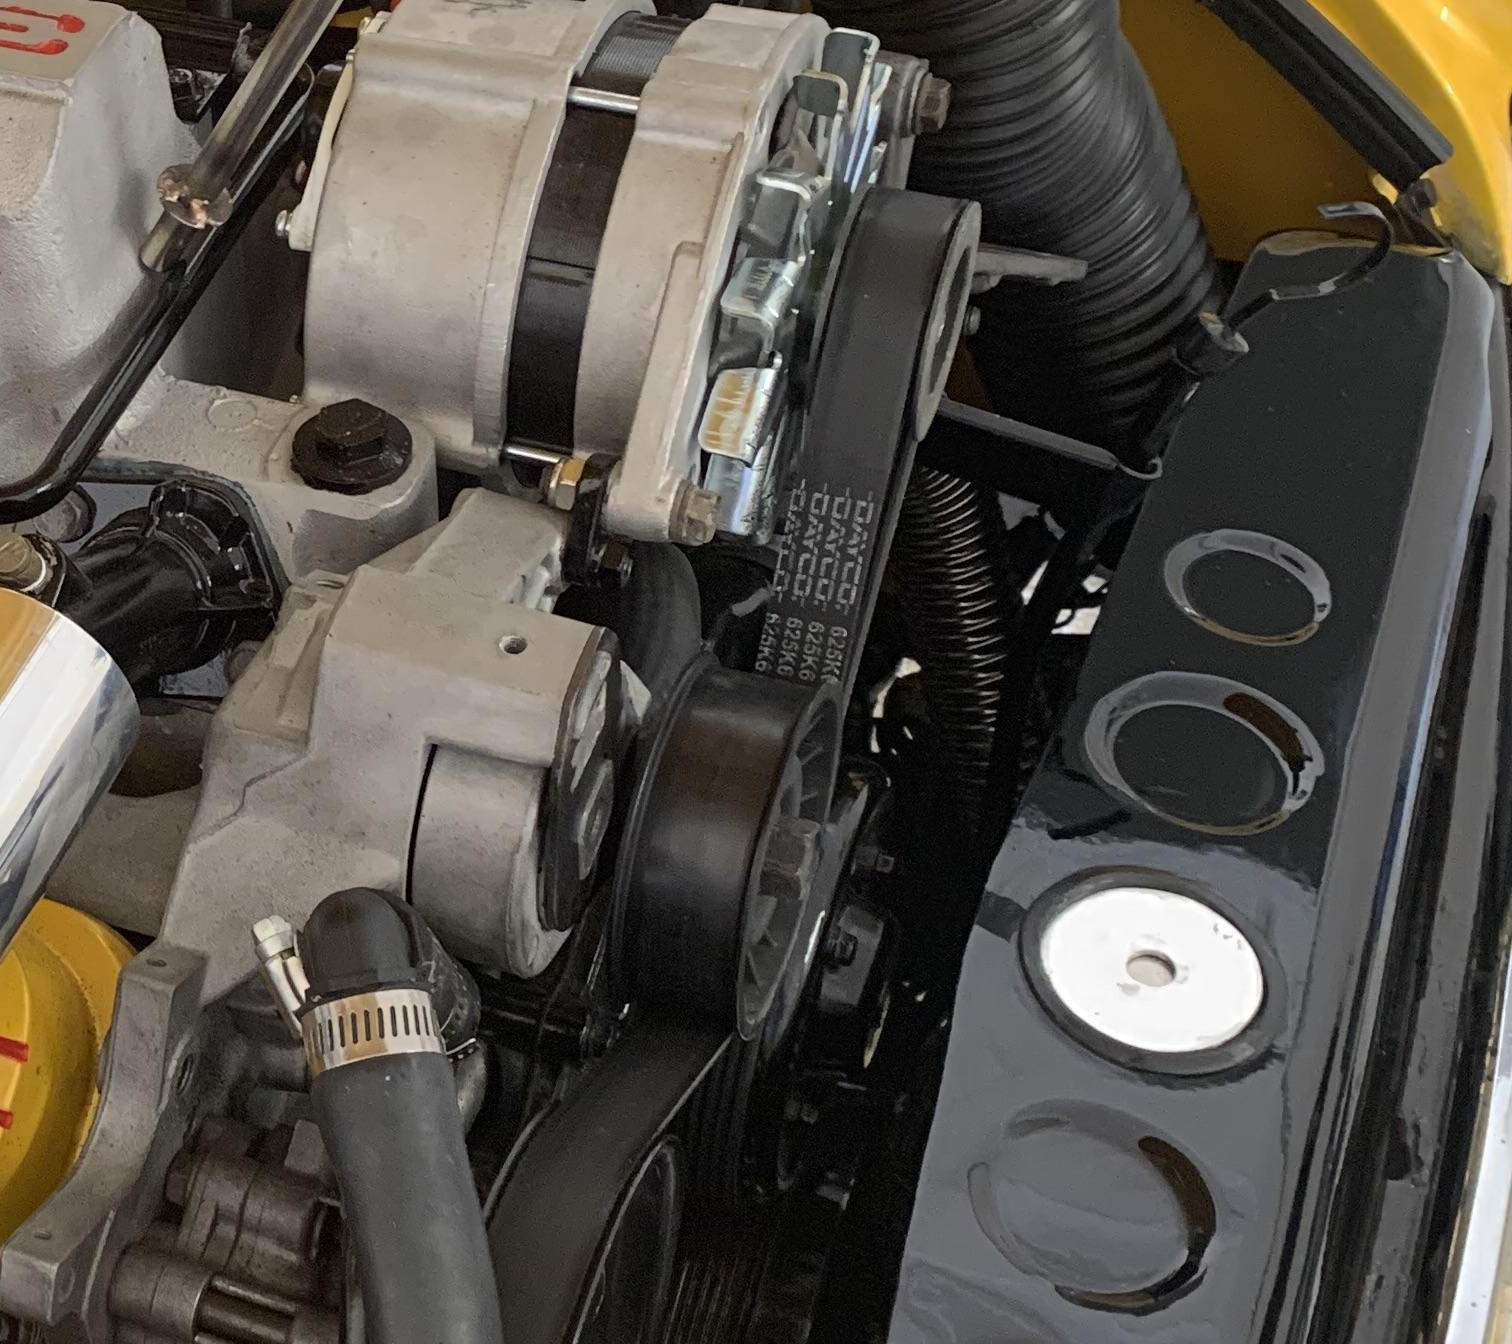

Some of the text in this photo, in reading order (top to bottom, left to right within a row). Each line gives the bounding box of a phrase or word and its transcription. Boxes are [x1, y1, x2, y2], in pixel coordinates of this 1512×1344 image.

[793, 492, 830, 597] DAYCO
[815, 496, 851, 601] DAYCO
[776, 617, 804, 676] 625K6
[799, 621, 825, 681] 625K6
